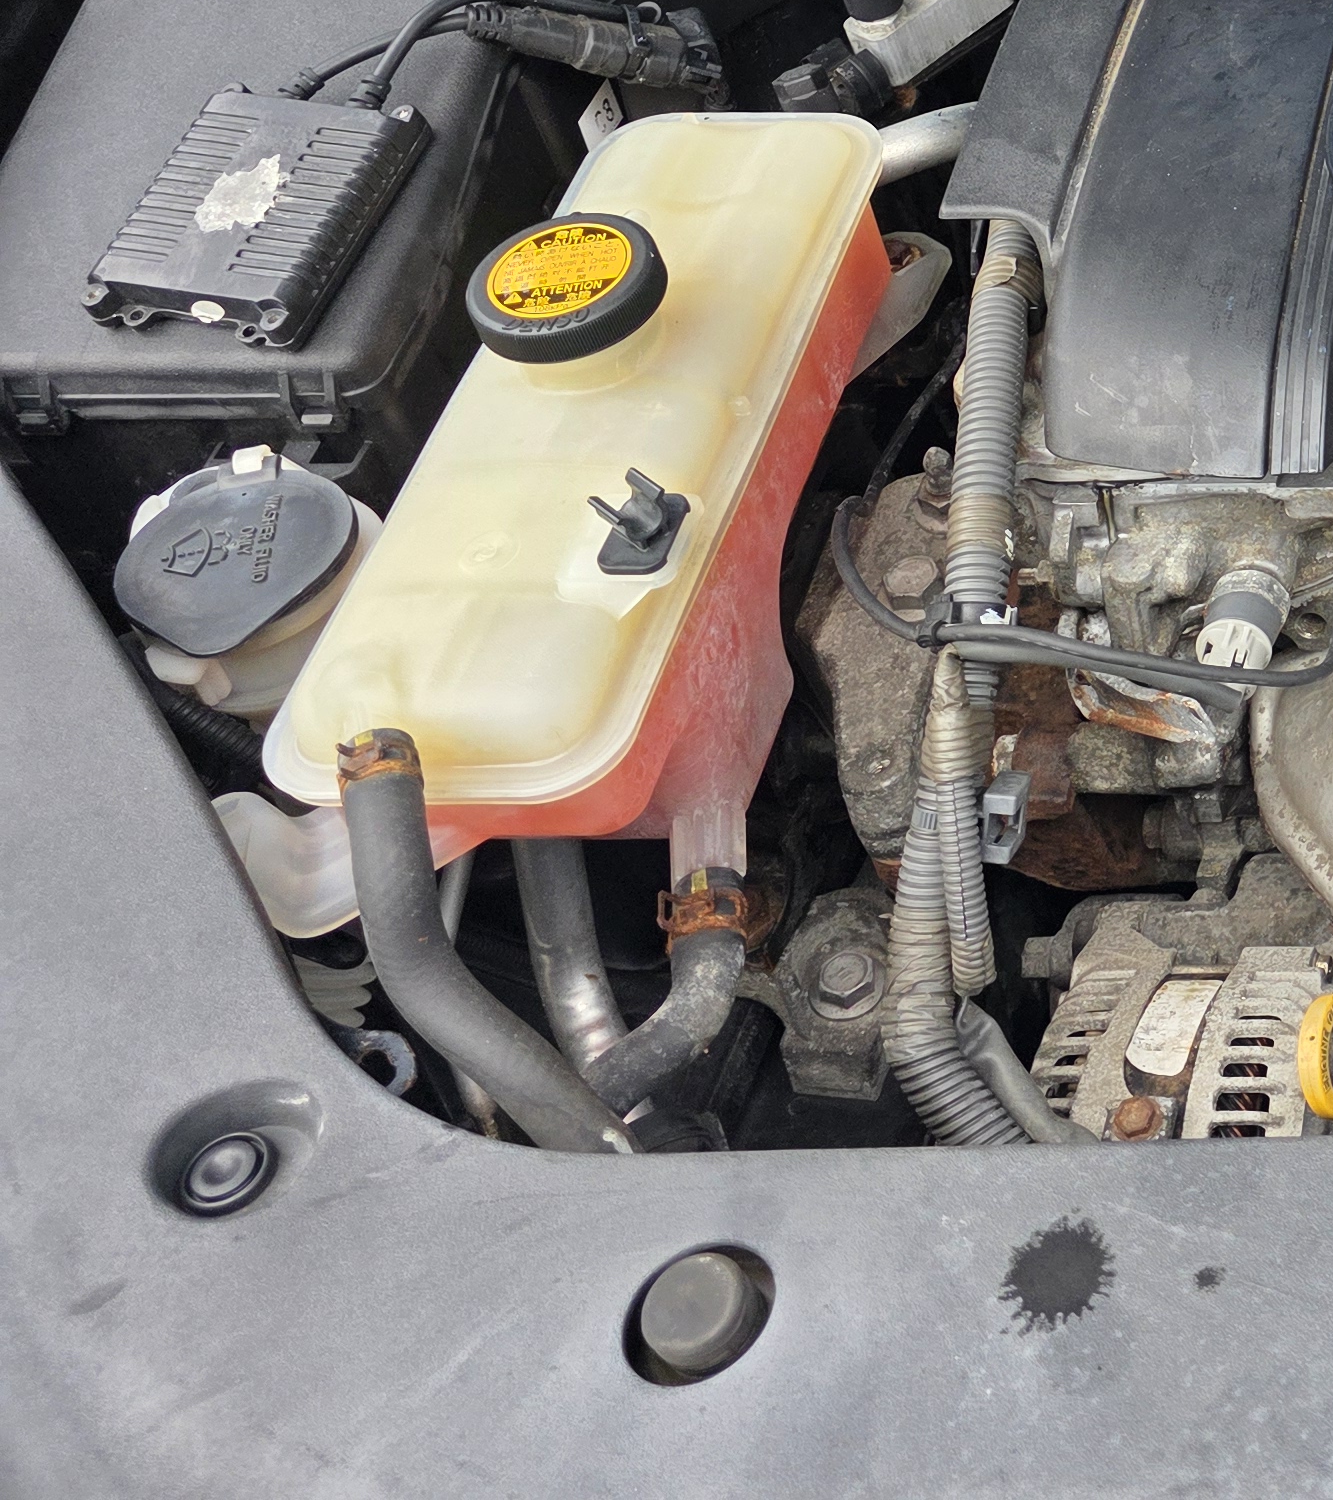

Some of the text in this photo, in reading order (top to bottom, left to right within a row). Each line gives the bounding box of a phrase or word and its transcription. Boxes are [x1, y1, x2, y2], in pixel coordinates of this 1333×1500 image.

[540, 233, 608, 249] CAUTION
[569, 250, 594, 259] WHEN
[530, 279, 603, 298] ATTENTION
[501, 307, 591, 333] DENSO
[236, 525, 257, 556] ONLY
[250, 492, 284, 584] WASHER FLUID
